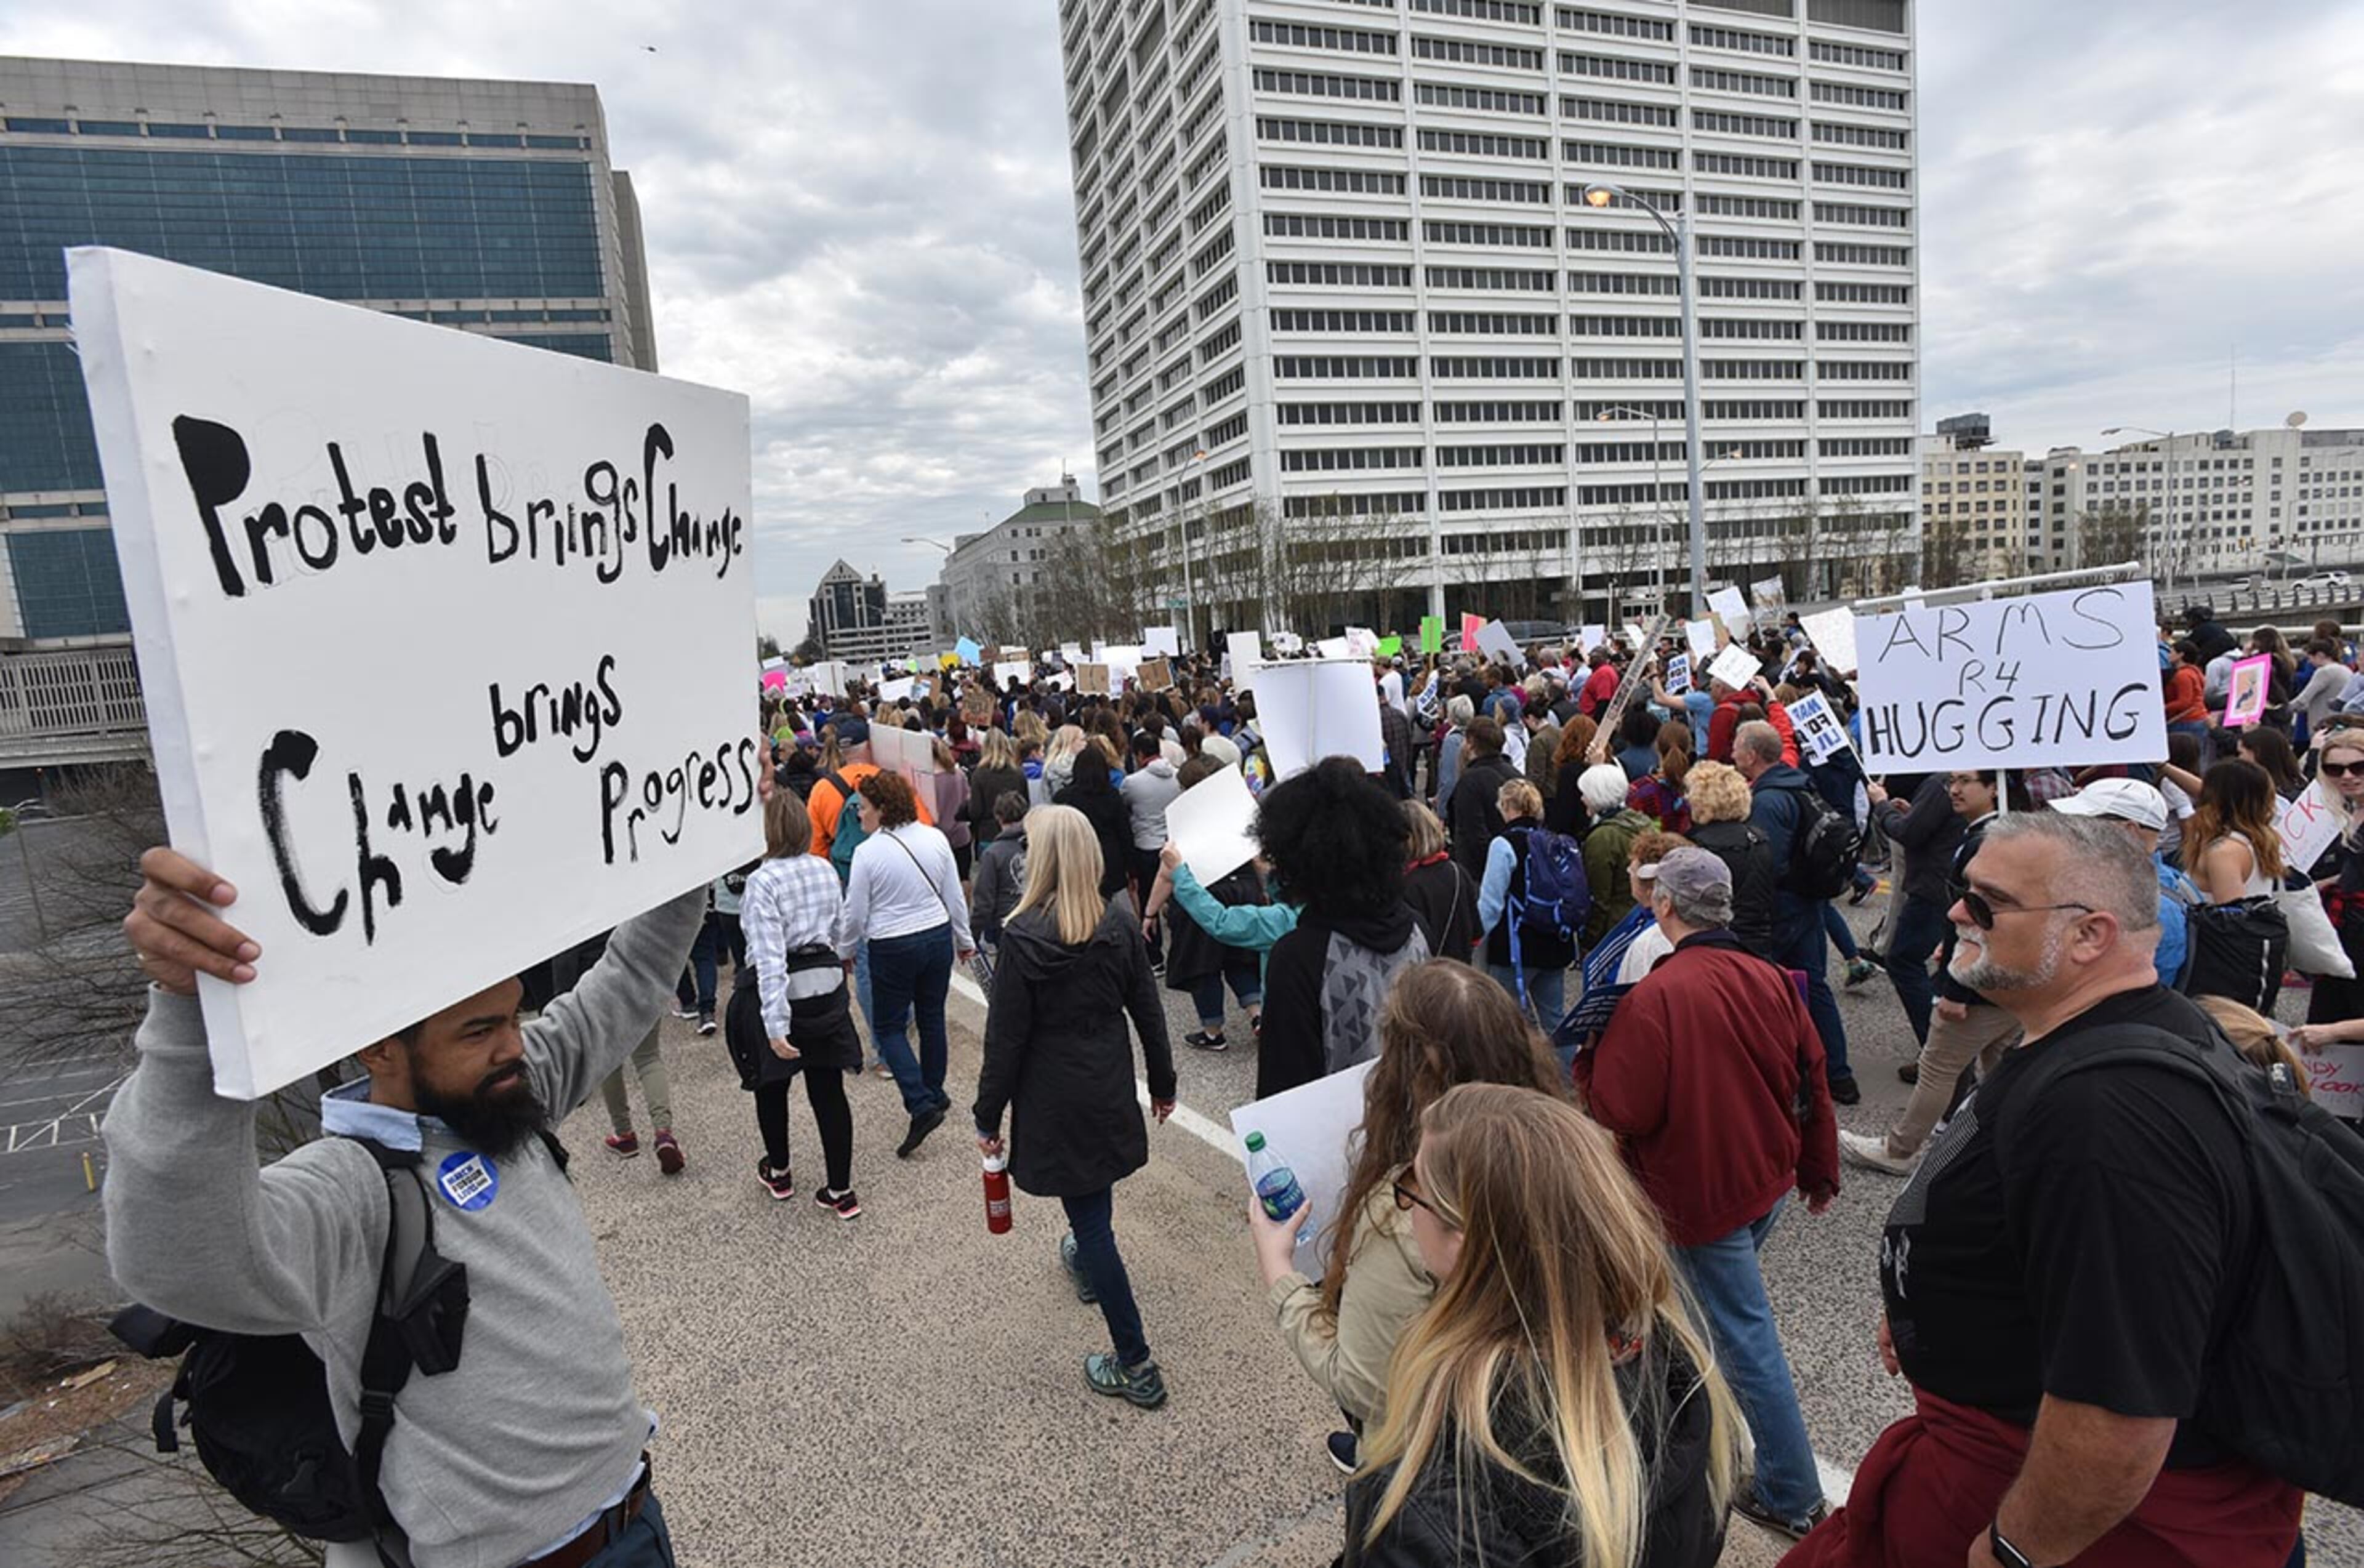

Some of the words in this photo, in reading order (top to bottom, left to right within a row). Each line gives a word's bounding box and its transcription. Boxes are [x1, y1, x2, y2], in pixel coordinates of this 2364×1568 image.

[171, 414, 457, 598] Protest
[643, 422, 742, 579] Change
[1878, 588, 2125, 663] ARMS
[488, 654, 622, 763] brings
[1865, 683, 2149, 758] HUGGING
[1958, 659, 2022, 697] R4
[256, 729, 499, 947] Change
[600, 737, 755, 865] Progress
